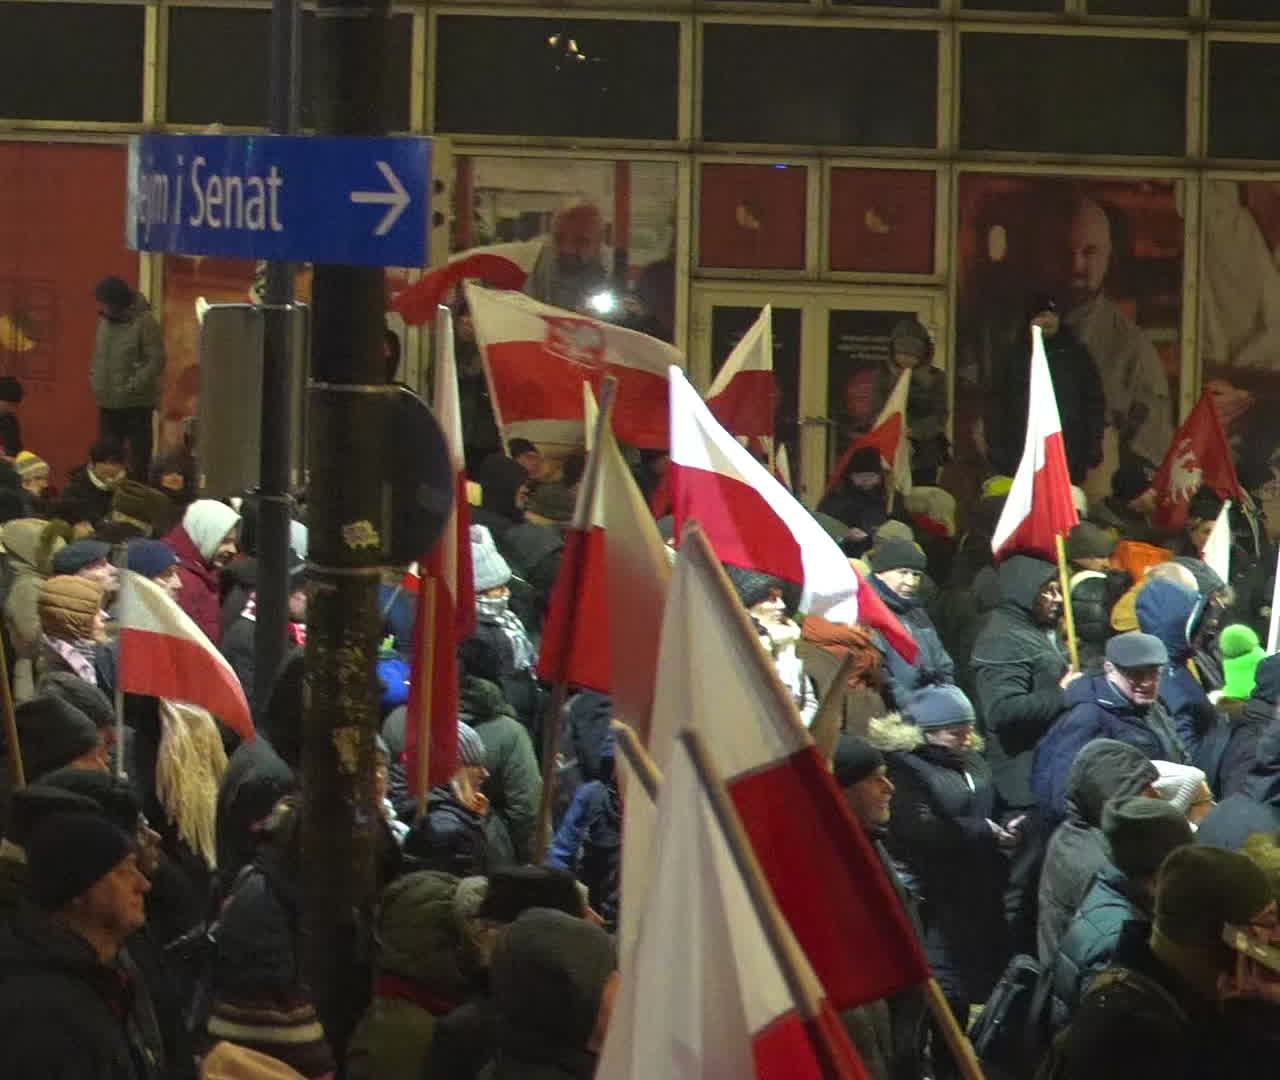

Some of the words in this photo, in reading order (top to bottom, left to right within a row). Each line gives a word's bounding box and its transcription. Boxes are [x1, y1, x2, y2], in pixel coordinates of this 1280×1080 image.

[138, 152, 169, 246] ejm
[175, 153, 184, 225] i
[190, 155, 284, 232] Senat
